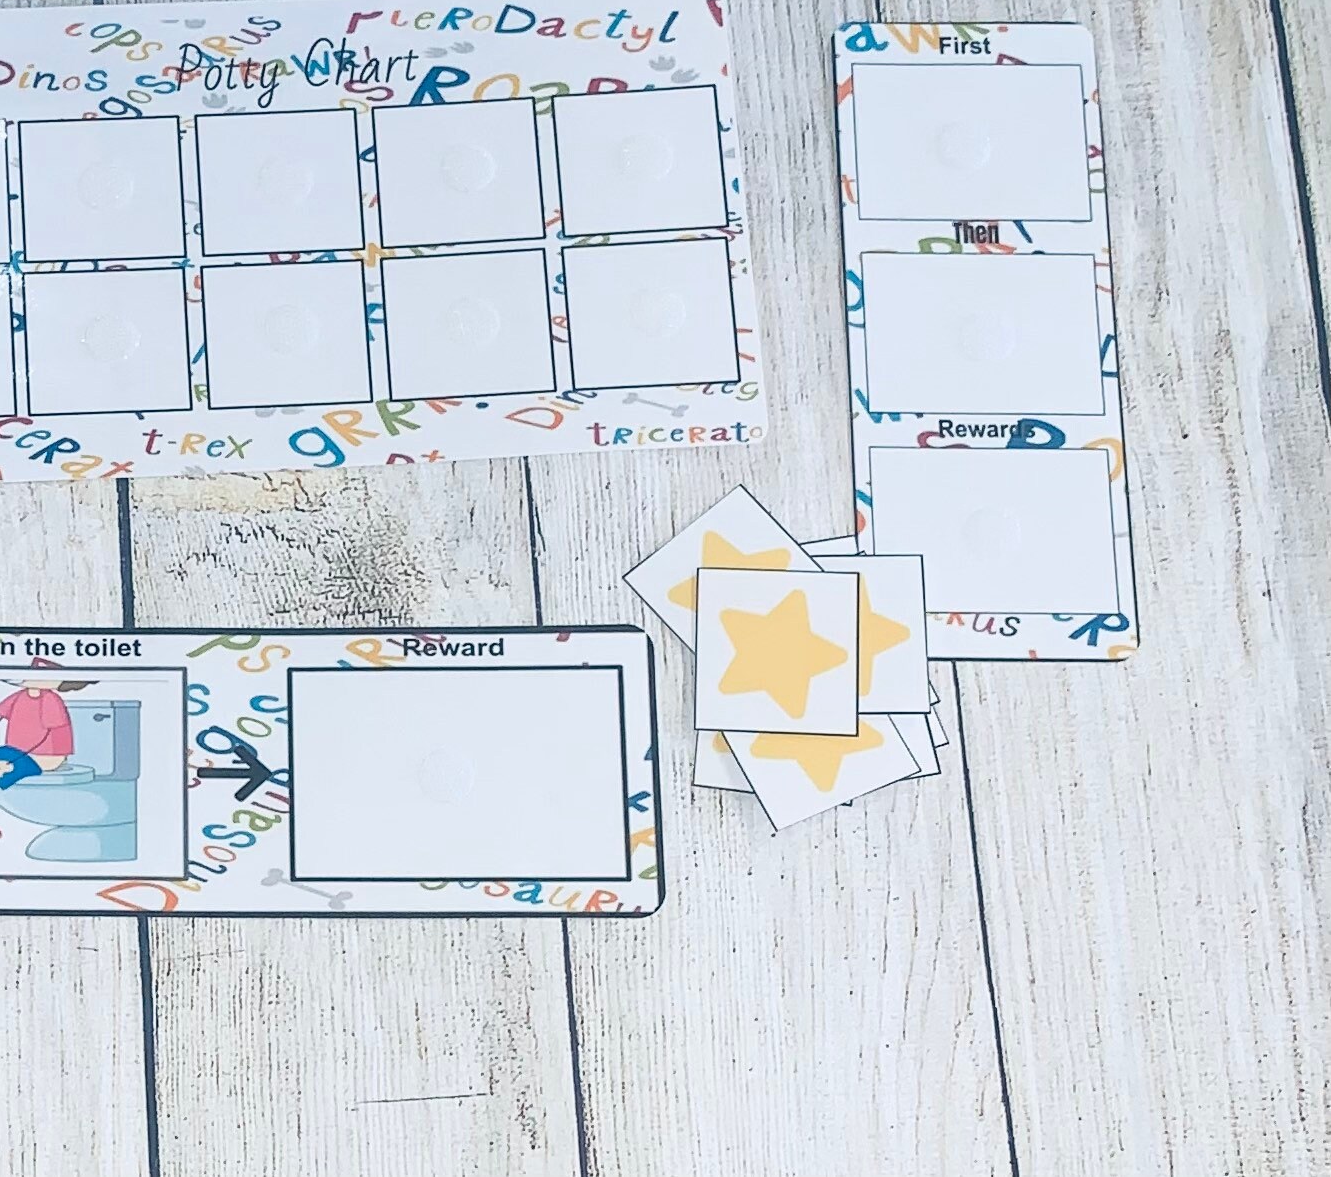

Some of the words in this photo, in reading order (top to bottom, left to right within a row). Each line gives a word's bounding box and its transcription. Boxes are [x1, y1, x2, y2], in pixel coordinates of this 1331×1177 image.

[938, 36, 991, 55] First
[178, 43, 280, 108] Potty
[304, 37, 420, 87] Chart
[952, 222, 1001, 245] Then
[938, 419, 1036, 439] Rewards
[143, 428, 253, 460] t-Rex
[24, 638, 66, 656] the
[75, 637, 142, 658] toilet
[402, 638, 505, 657] Reward
